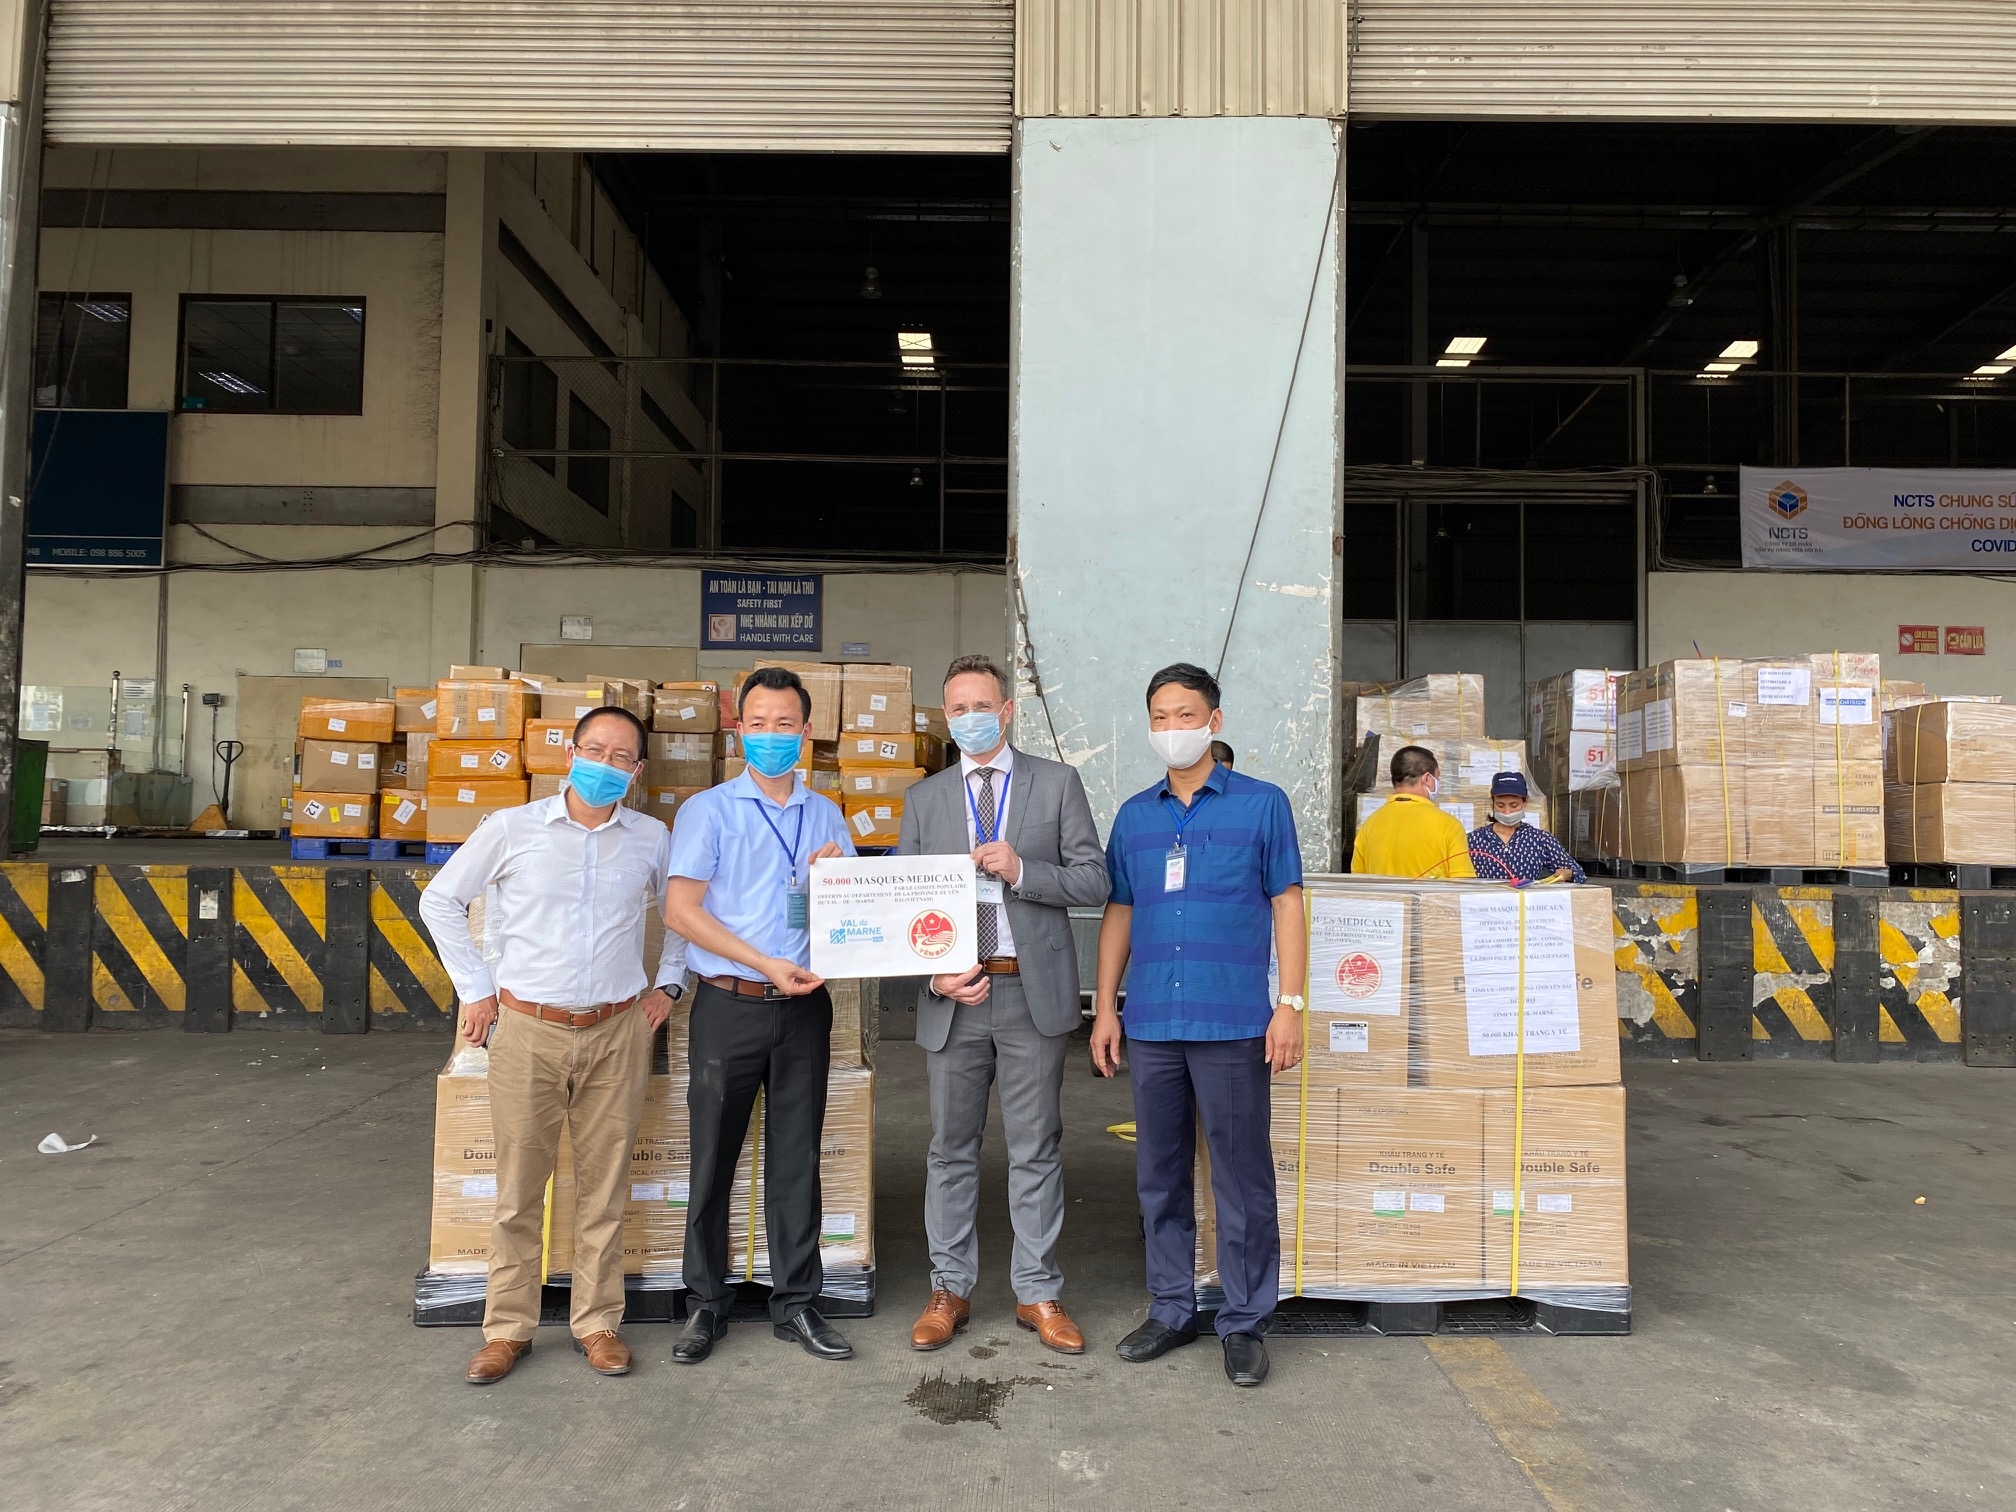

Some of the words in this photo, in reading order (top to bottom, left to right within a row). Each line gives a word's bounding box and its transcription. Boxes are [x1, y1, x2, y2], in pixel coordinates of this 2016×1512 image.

[1893, 494, 1935, 508] NCTS
[1938, 494, 1994, 508] CHUNG
[1892, 513, 1936, 530] LÒNG
[2000, 516, 2016, 534] DỊ
[1768, 526, 1808, 540] NCTS
[1972, 539, 2016, 553] COVID
[52, 548, 88, 557] MOBILE:
[90, 548, 106, 557] 098
[108, 548, 124, 558] 886
[125, 549, 146, 558] 5005
[709, 580, 718, 594] AN
[720, 578, 737, 594] TOÀN
[738, 578, 746, 594] LÀ
[748, 580, 762, 596] BẠN
[767, 580, 777, 594] TAI
[778, 580, 792, 596] NẠN
[793, 578, 802, 594] LÀ
[737, 598, 762, 608] SAFETY
[763, 599, 783, 608] FIRST
[740, 614, 754, 630] NHẸ
[754, 613, 777, 628] NHÀNG
[778, 614, 790, 628] KHI
[740, 633, 770, 643] HANDLE
[773, 634, 790, 643] WITH
[792, 634, 814, 643] CARE
[548, 730, 559, 744] 12
[882, 743, 896, 755] 12
[491, 751, 507, 767] 12
[394, 764, 407, 775] 12
[305, 801, 320, 816] 12
[822, 877, 851, 886] 50.000
[853, 875, 904, 886] MASQUES
[907, 873, 964, 883] MEDICAUX
[840, 919, 858, 927] VAL
[1338, 918, 1392, 928] MEDICAUX
[847, 927, 882, 936] MARNE
[920, 948, 934, 956] YÊN
[632, 1150, 662, 1161] uble
[1369, 1162, 1420, 1174] Double
[1425, 1163, 1456, 1174] Safe
[1570, 1162, 1600, 1173] Safe
